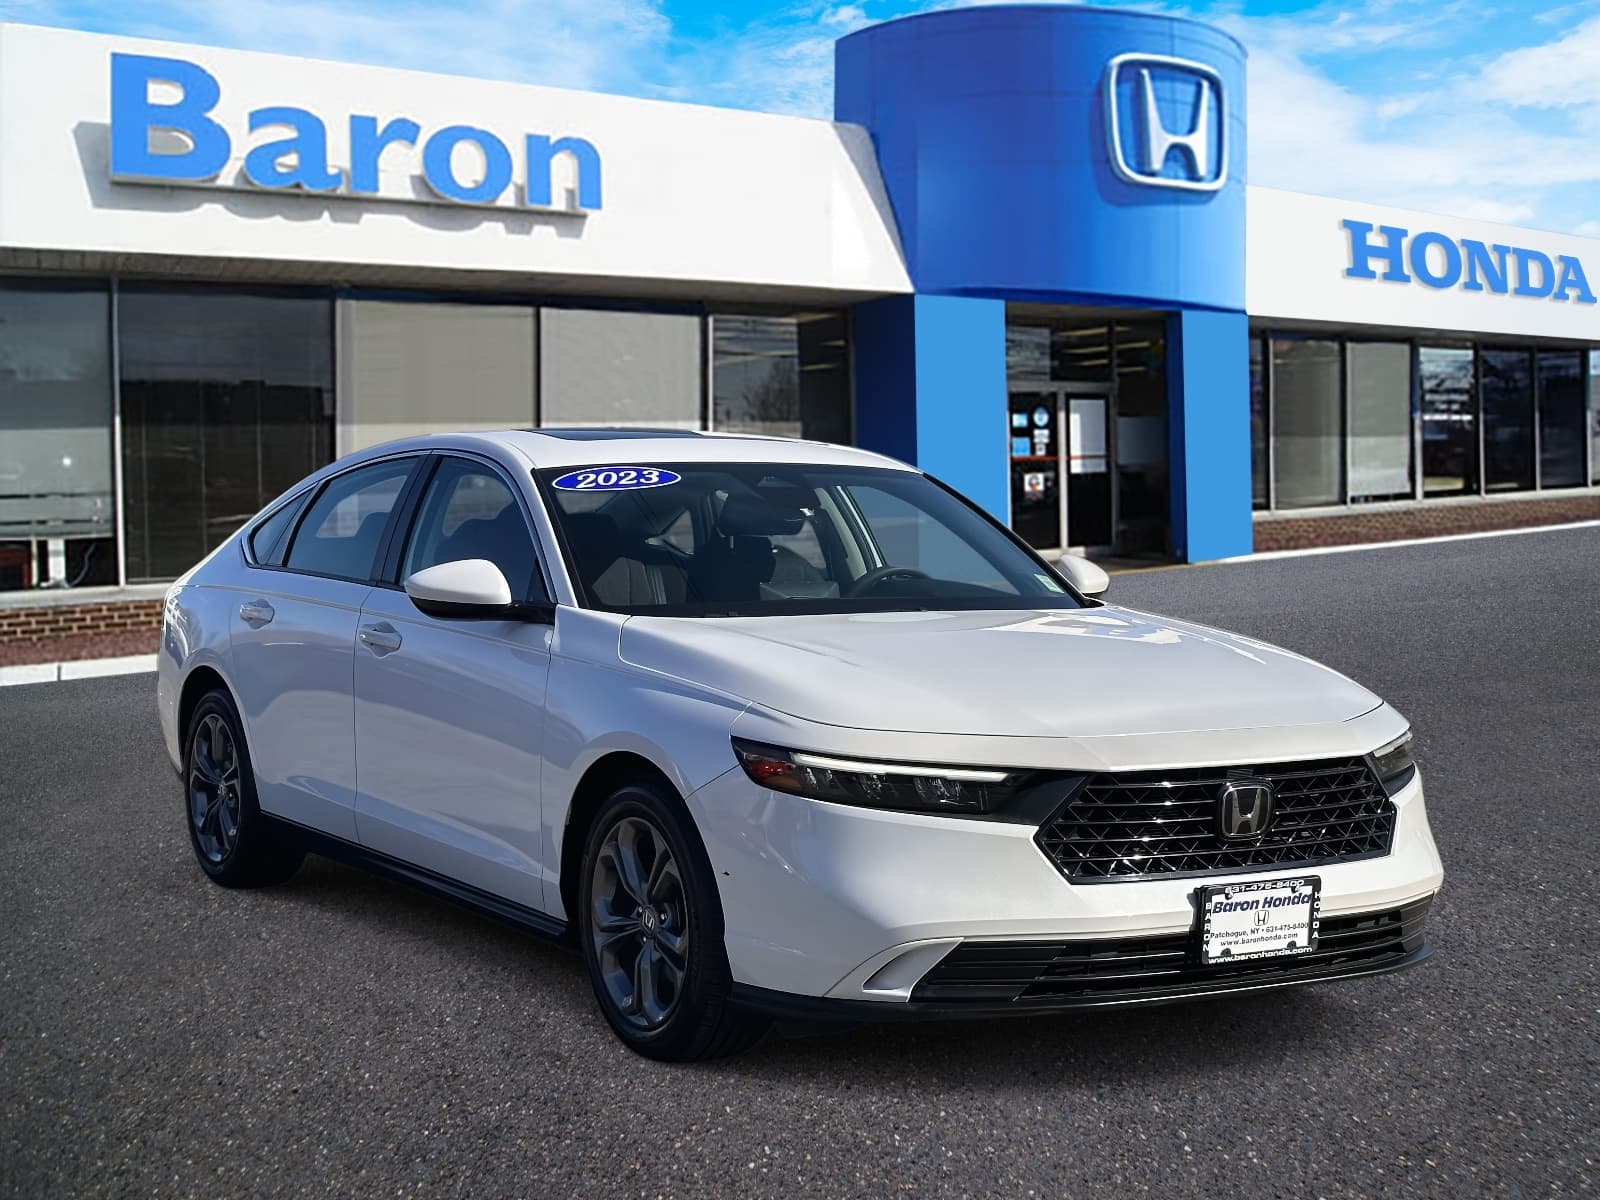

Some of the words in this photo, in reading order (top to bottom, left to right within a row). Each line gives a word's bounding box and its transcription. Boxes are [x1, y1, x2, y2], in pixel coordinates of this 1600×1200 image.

[110, 52, 602, 210] Baron
[1342, 219, 1597, 304] HONDA
[576, 471, 660, 489] 2023
[1212, 901, 1259, 913] Baron
[1262, 893, 1312, 909] Honda
[1210, 931, 1249, 939] Patchogue,
[1208, 946, 1312, 964] www.baronhonda.com
